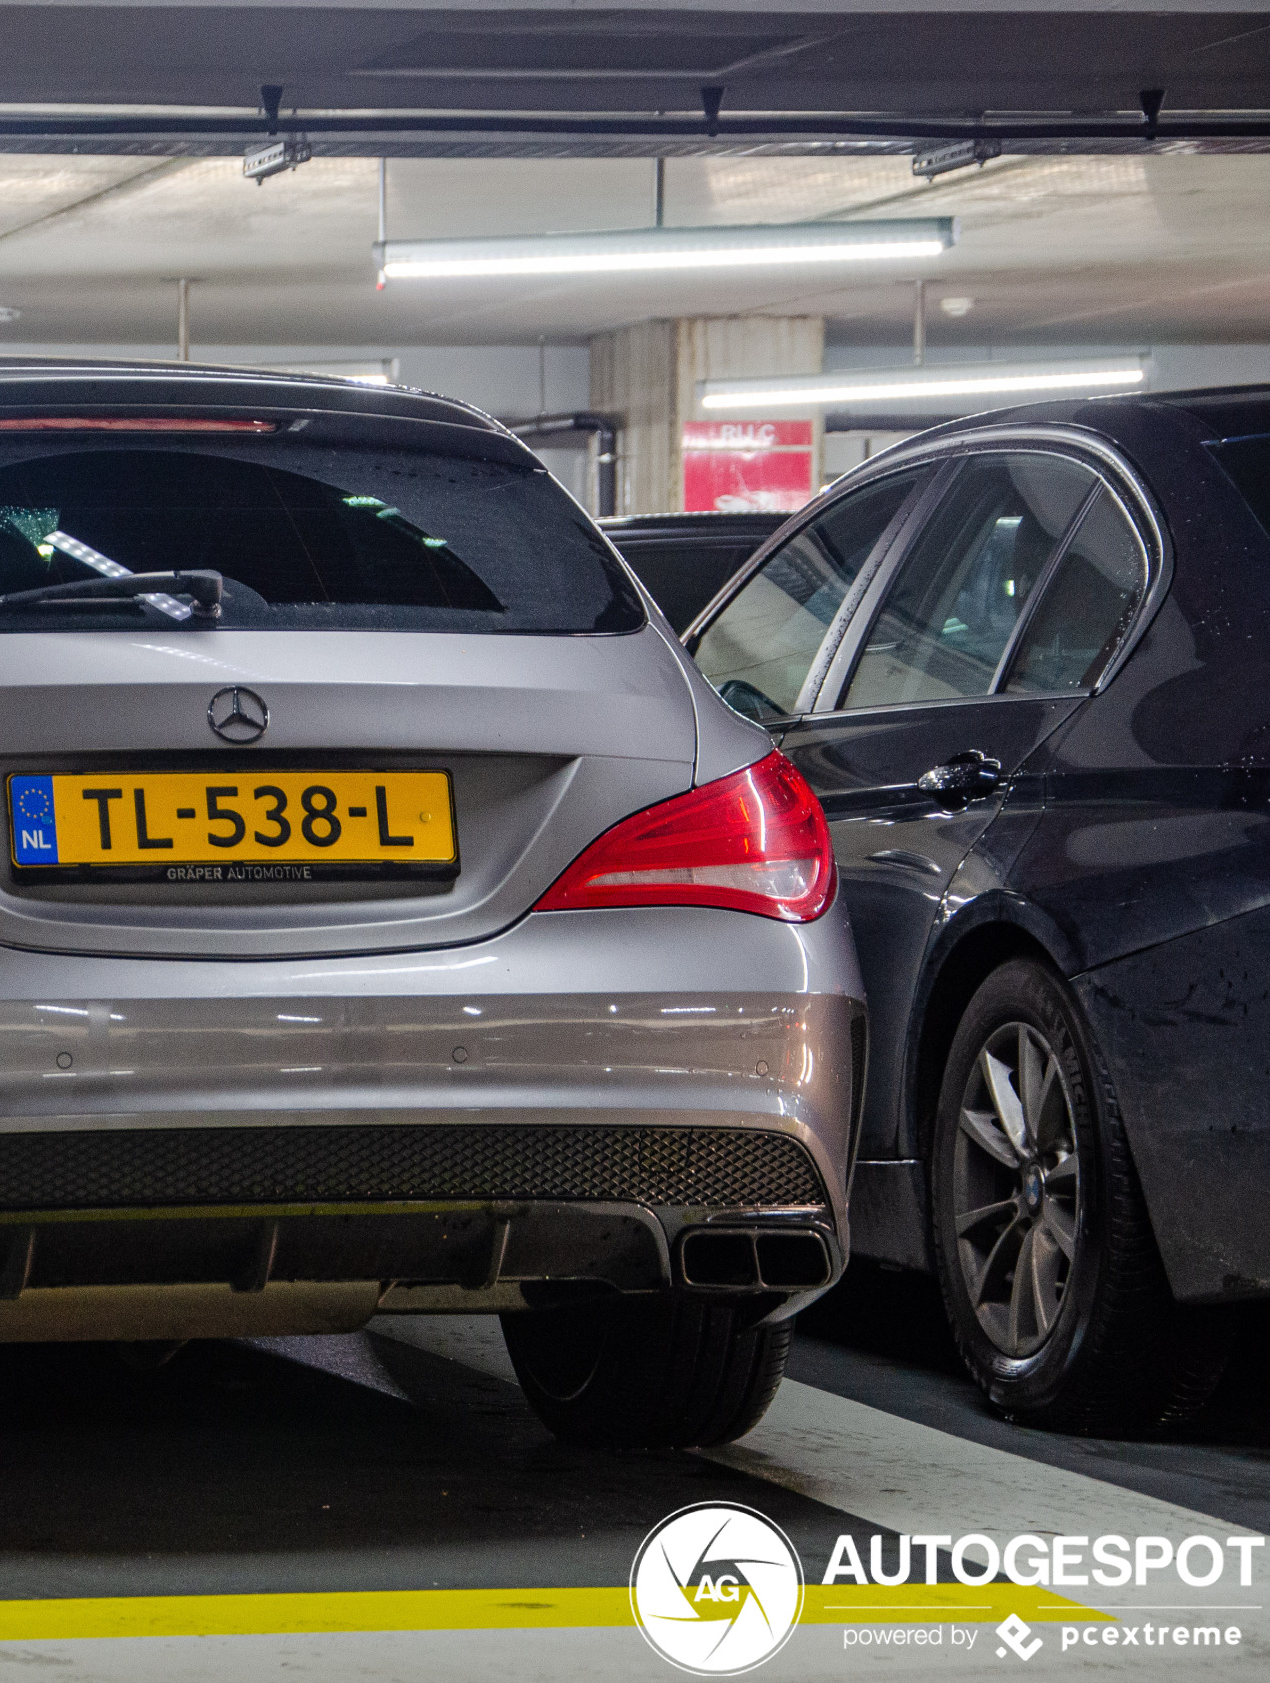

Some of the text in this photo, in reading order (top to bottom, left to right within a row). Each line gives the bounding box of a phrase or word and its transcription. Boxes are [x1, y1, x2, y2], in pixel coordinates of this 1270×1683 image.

[82, 785, 414, 850] TL-538-L
[22, 830, 52, 849] NL
[166, 865, 312, 880] GRÄPER AUTOMOTIVE
